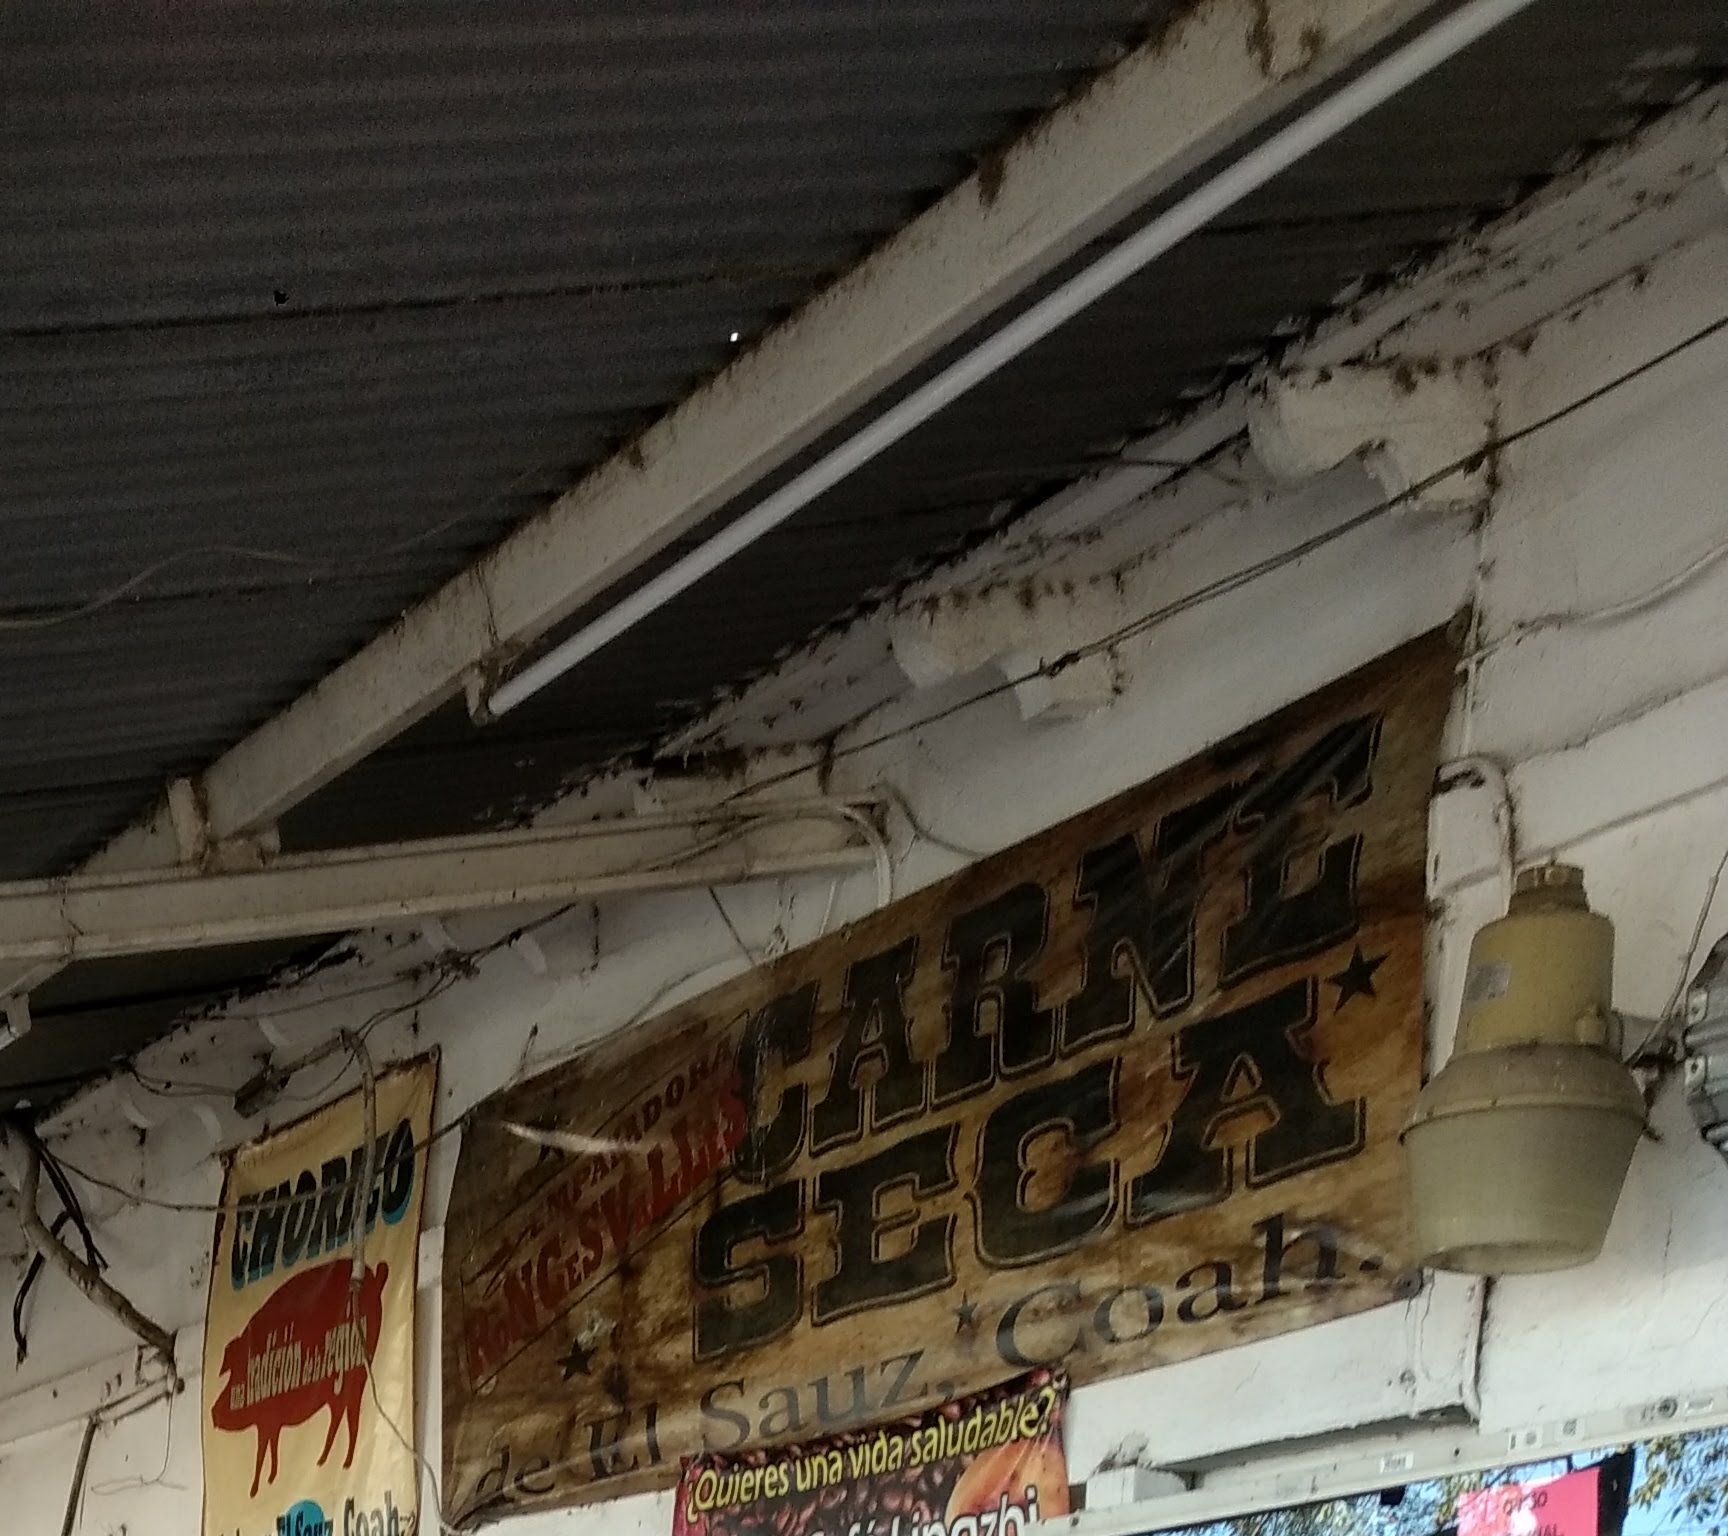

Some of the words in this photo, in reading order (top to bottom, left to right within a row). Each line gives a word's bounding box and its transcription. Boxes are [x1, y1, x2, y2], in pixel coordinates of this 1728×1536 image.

[737, 710, 1384, 1184] CARNE
[692, 976, 1369, 1362] SECA
[247, 1321, 303, 1407] tradición
[324, 1300, 368, 1396] región
[475, 1435, 556, 1509] de
[586, 1403, 663, 1482] El
[995, 1214, 1384, 1372] Coah.
[686, 1461, 790, 1524] ¿Quieres
[796, 1452, 844, 1491] una
[848, 1430, 905, 1474] vida
[909, 1386, 1057, 1464] saludable?
